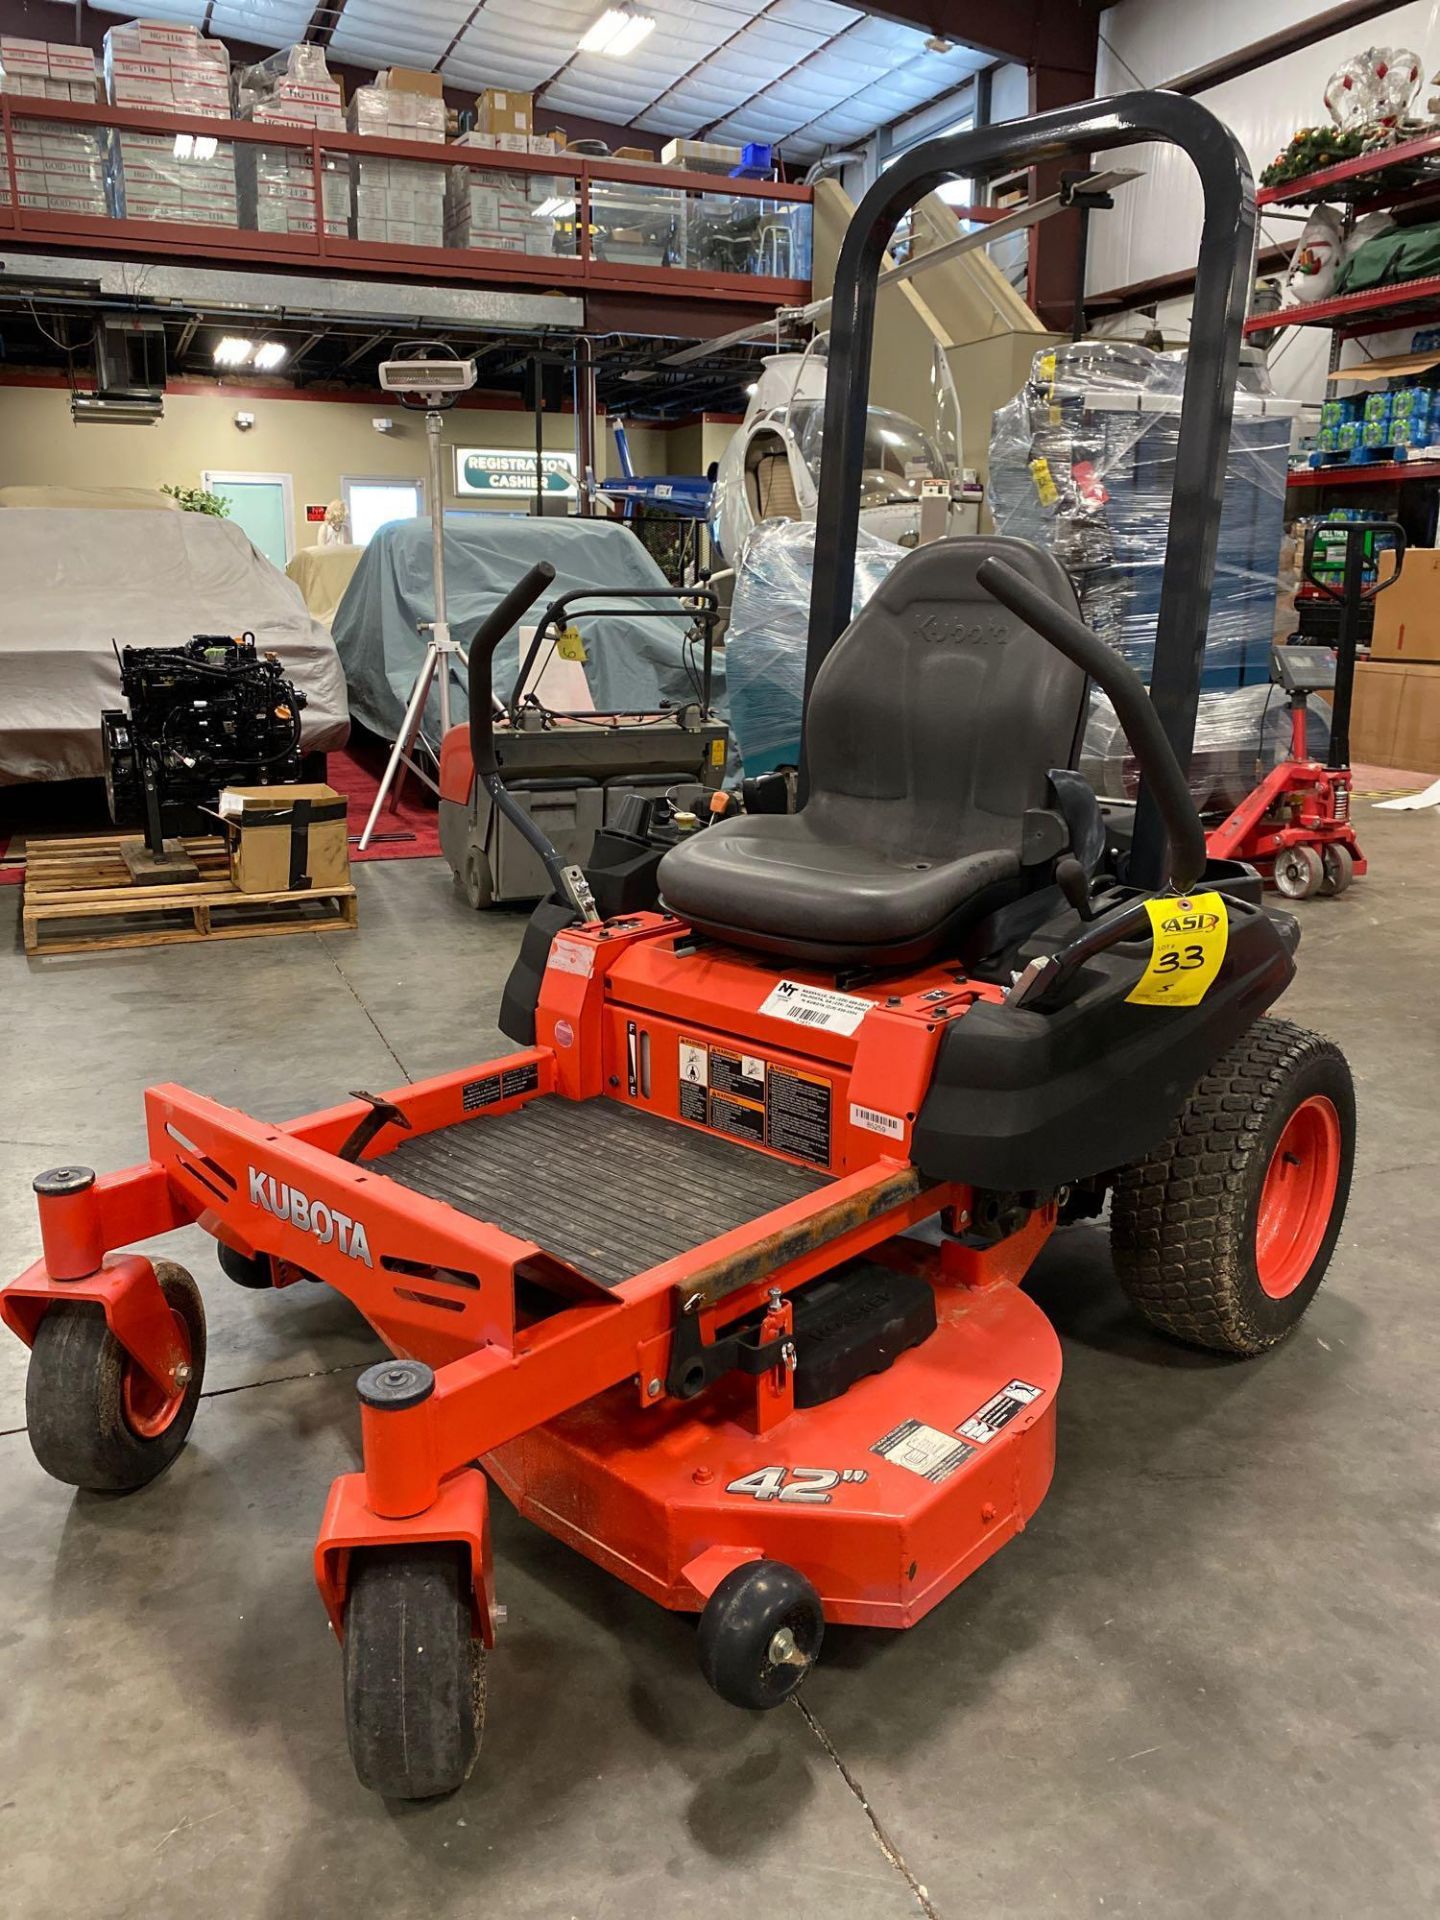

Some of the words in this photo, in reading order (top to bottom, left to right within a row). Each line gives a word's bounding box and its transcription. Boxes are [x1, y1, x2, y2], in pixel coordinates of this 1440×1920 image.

[468, 456, 568, 472] REGISTRAION
[1153, 945, 1205, 974] 33
[629, 1023, 635, 1032] F
[631, 1086, 636, 1096] E
[248, 1165, 374, 1269] KUBOTA
[725, 1465, 868, 1504] 42"
